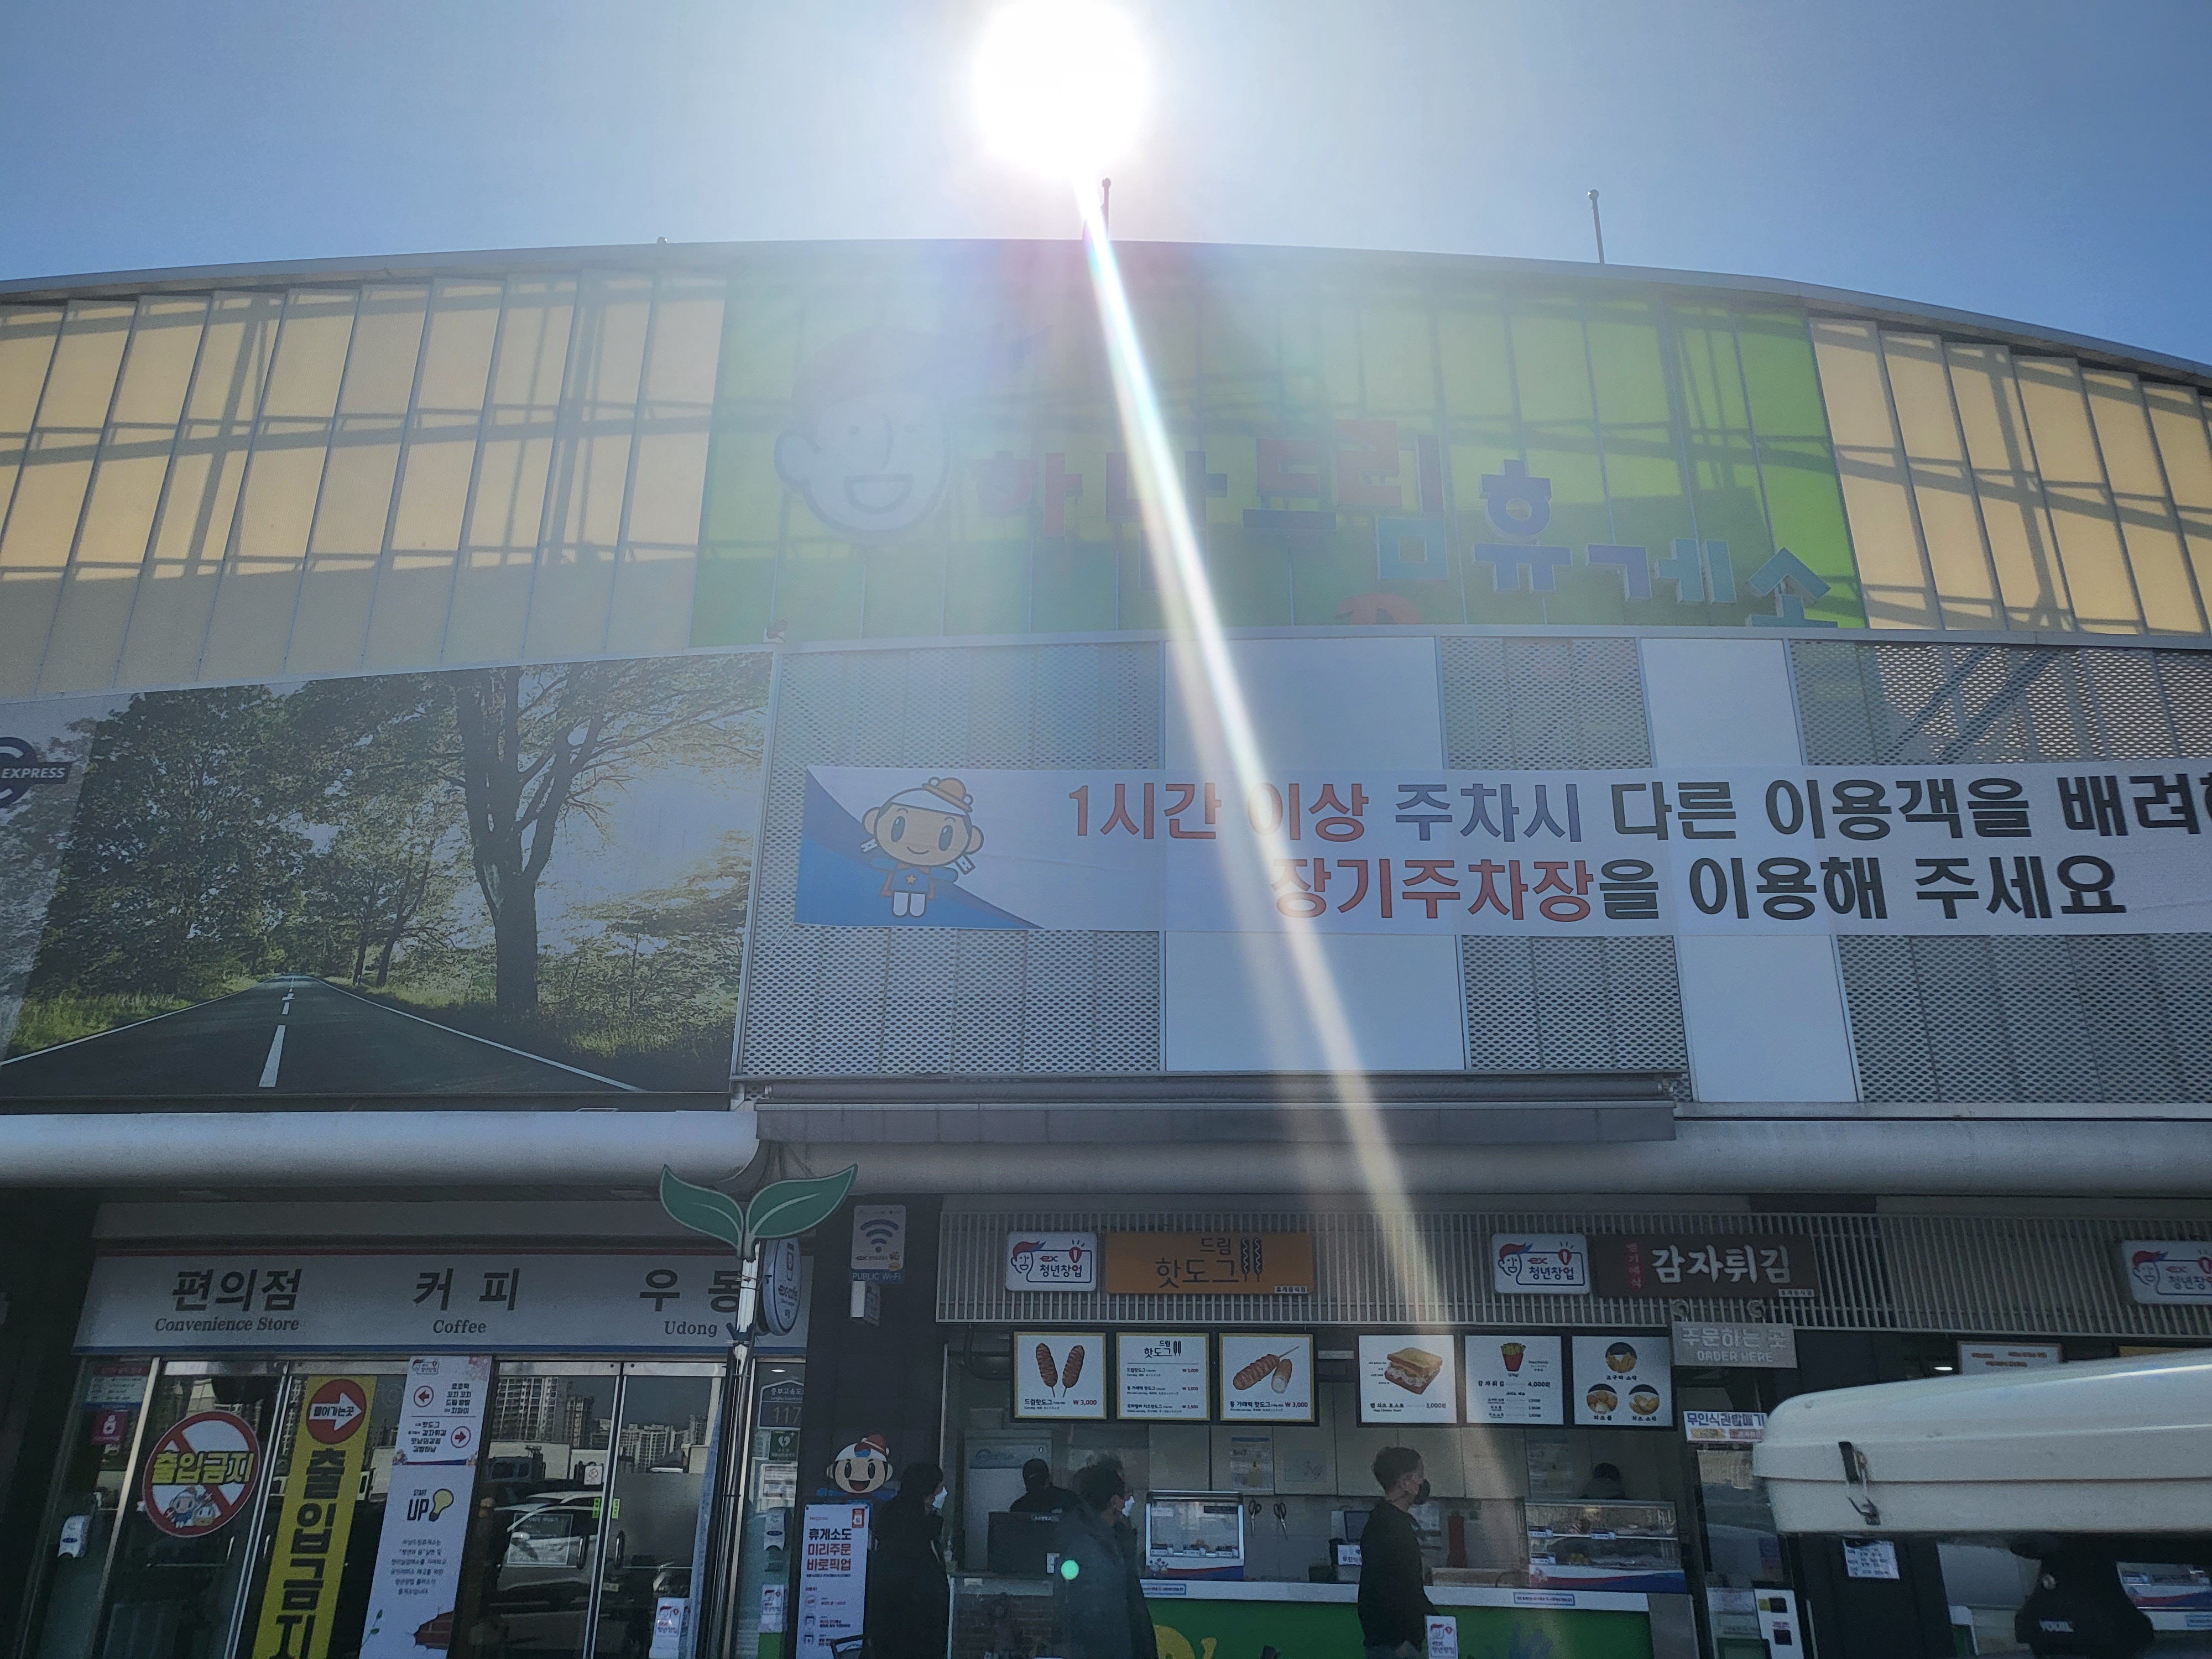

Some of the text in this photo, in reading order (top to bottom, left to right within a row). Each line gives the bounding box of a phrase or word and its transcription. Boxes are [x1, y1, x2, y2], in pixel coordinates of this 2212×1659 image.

[2, 767, 66, 779] EXPRESS
[1069, 782, 1222, 841] 1시간
[1248, 782, 1369, 842] 이상
[1396, 782, 1582, 842] 주차시
[1611, 780, 1737, 841] 다른
[1765, 776, 2032, 842] 이용객을
[1272, 854, 2128, 921] 장기주차장을 이용해 주세요
[1199, 1238, 1232, 1255] 드림
[1039, 1264, 1083, 1277] 청년창업
[1154, 1258, 1239, 1289] 핫도그
[1528, 1266, 1574, 1280] 청년창업
[1651, 1244, 1791, 1284] 감자튀김
[171, 1268, 302, 1311] 편의점
[154, 1316, 718, 1338] Convenience Store Coffee Udong
[1681, 1327, 1787, 1348] 주문하는 곳
[1144, 1347, 1172, 1359] 핫도그
[1697, 1350, 1773, 1363] ORDER HERE
[151, 1450, 255, 1484] 출입금지
[407, 1499, 430, 1521] UP
[809, 1528, 852, 1540] 휴게소도
[269, 1448, 346, 1659] 출입금지
[808, 1543, 851, 1556] 미리주문
[807, 1558, 851, 1571] 바로픽업
